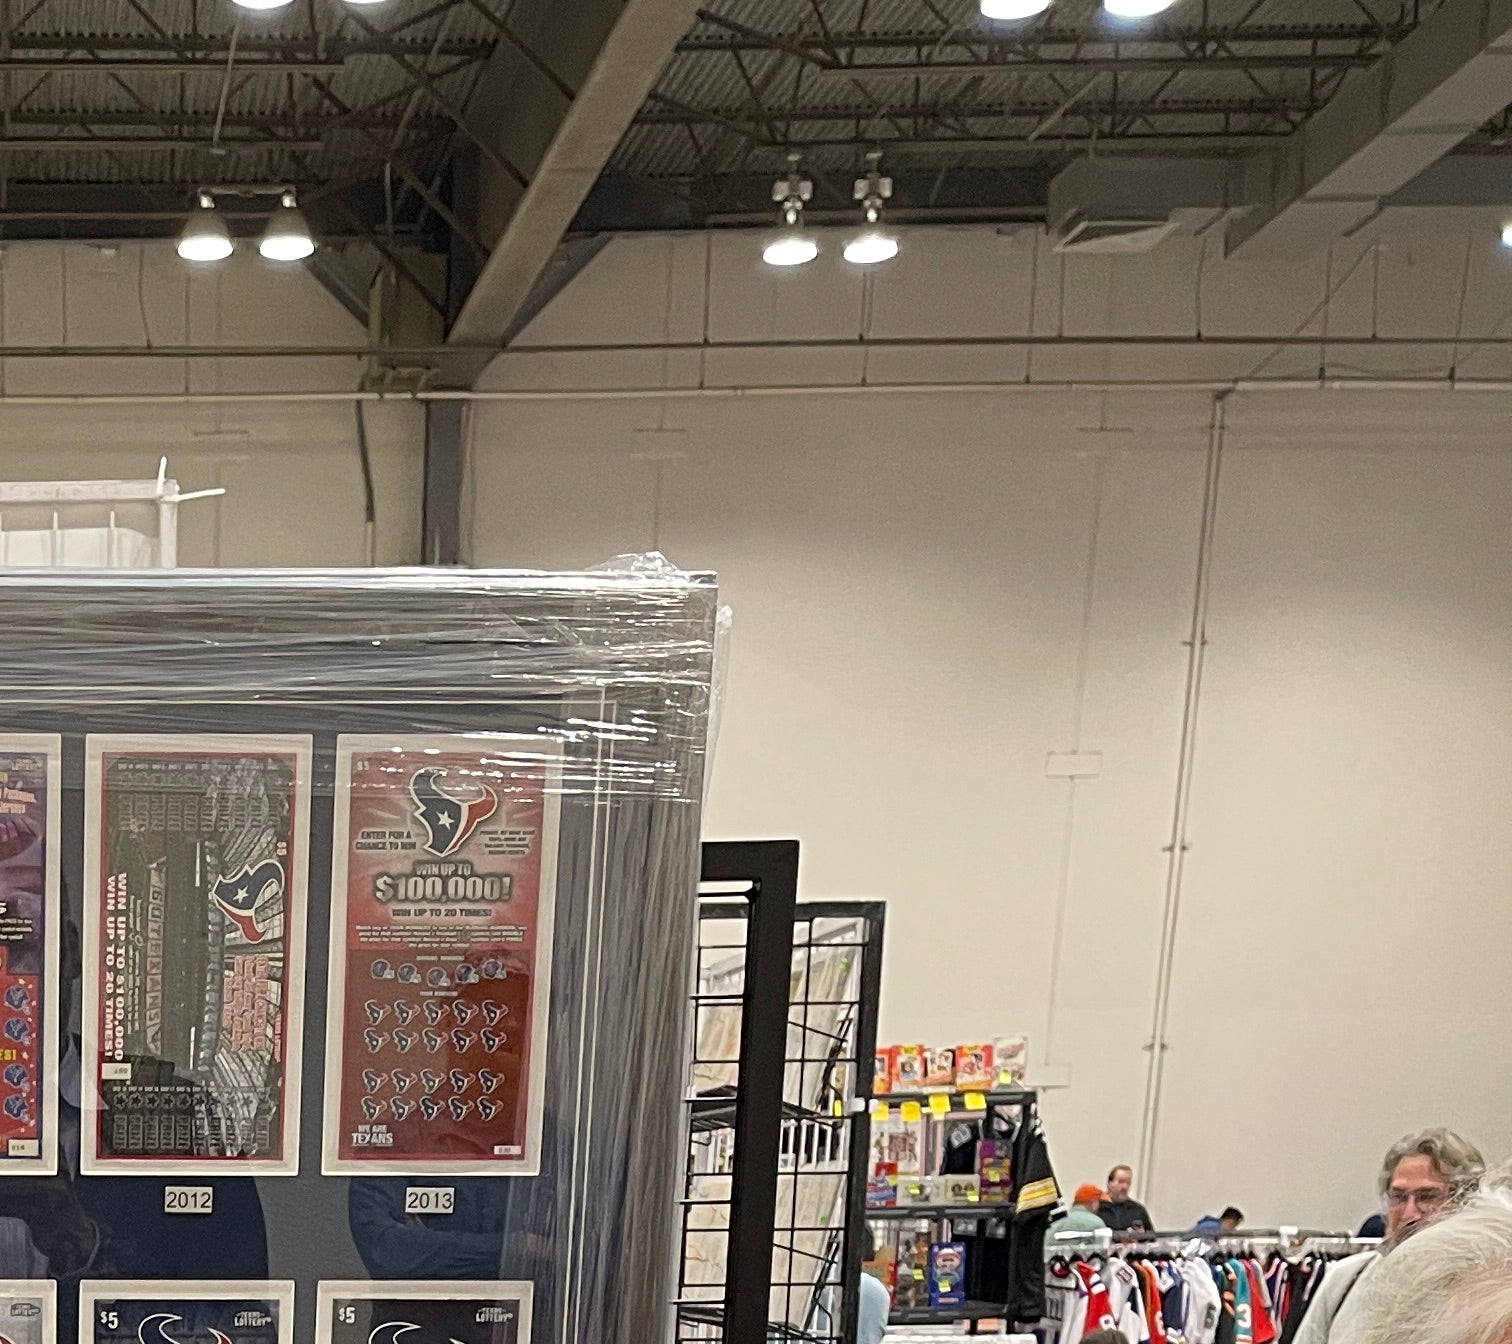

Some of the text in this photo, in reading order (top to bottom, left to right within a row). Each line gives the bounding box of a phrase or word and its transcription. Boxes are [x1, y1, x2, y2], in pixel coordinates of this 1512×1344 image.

[375, 875, 512, 902] $100,000!
[166, 1192, 211, 1209] 2012
[408, 1192, 452, 1209] 2013
[100, 1311, 119, 1329] $5
[338, 1306, 355, 1323] $5
[1237, 1304, 1251, 1328] 3
